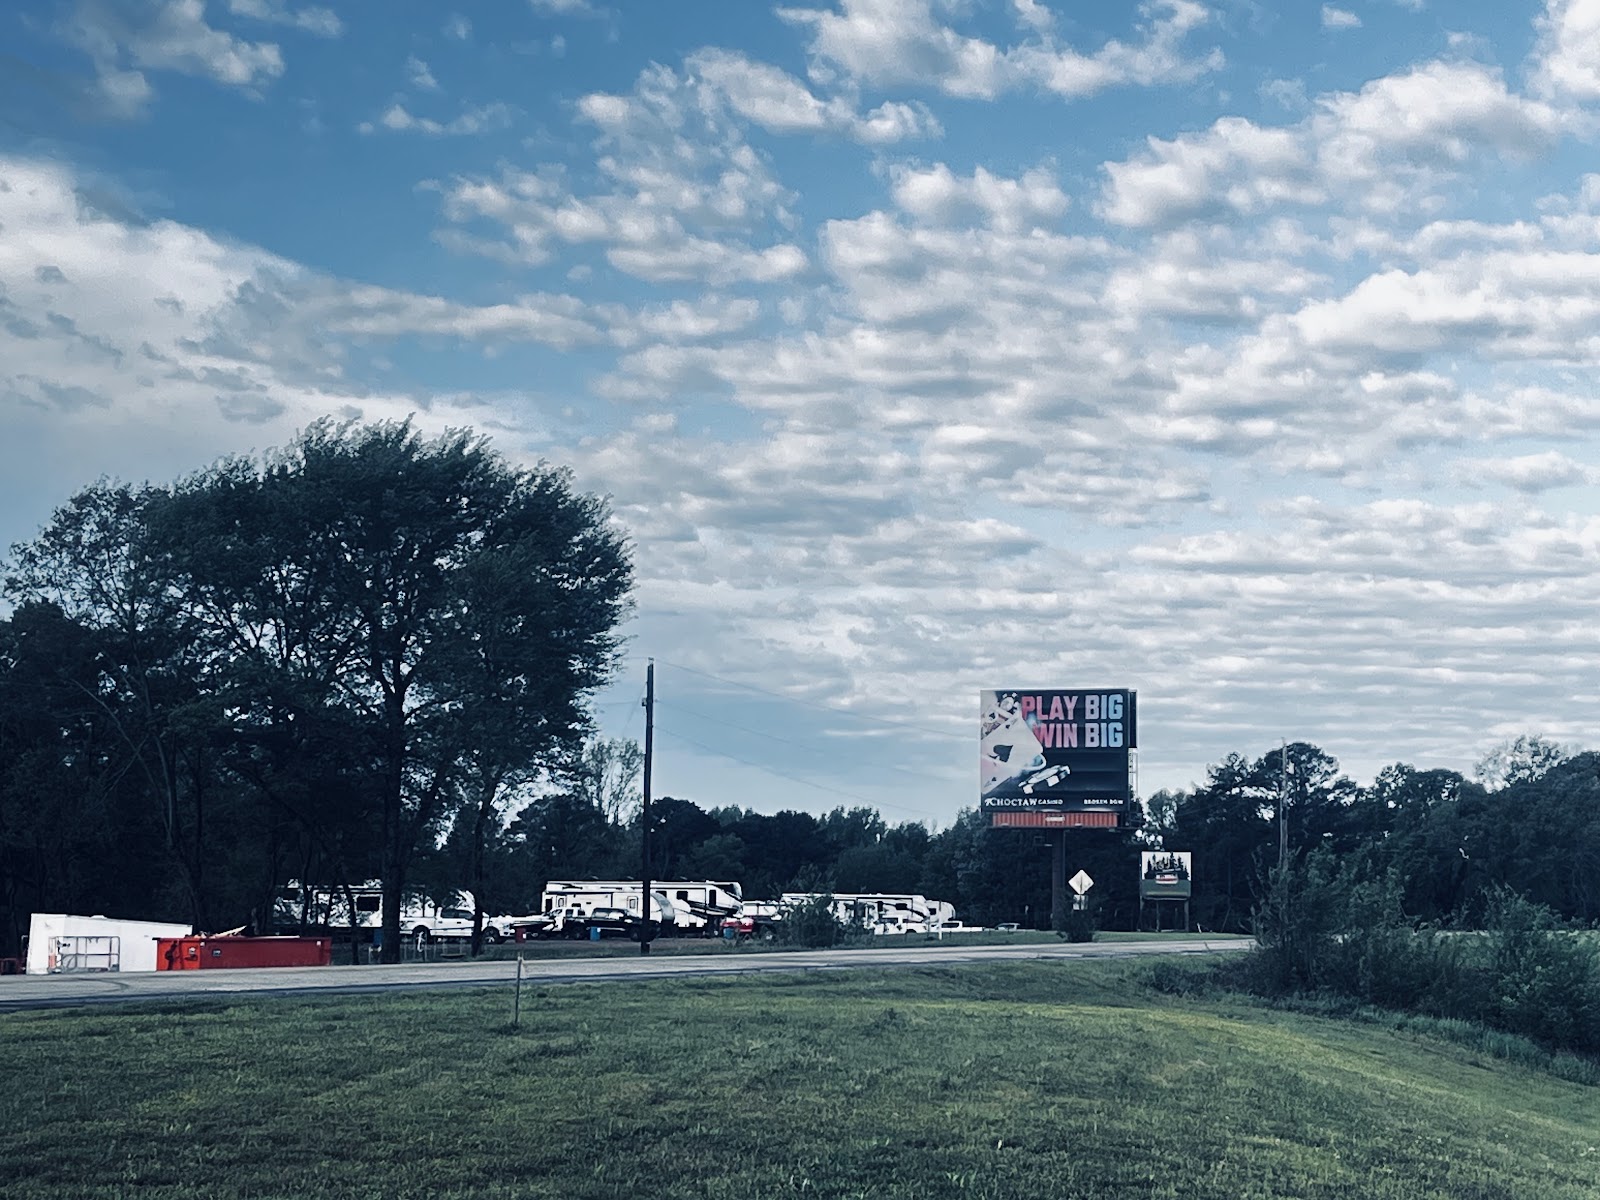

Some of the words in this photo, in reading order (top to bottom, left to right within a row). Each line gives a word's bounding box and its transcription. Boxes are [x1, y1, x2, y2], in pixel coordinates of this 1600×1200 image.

[1021, 695, 1078, 720] PLAY
[1085, 694, 1124, 720] BIG
[1032, 722, 1078, 748] WIN
[1085, 722, 1124, 748] BIG
[990, 797, 1038, 806] CHOCTAW
